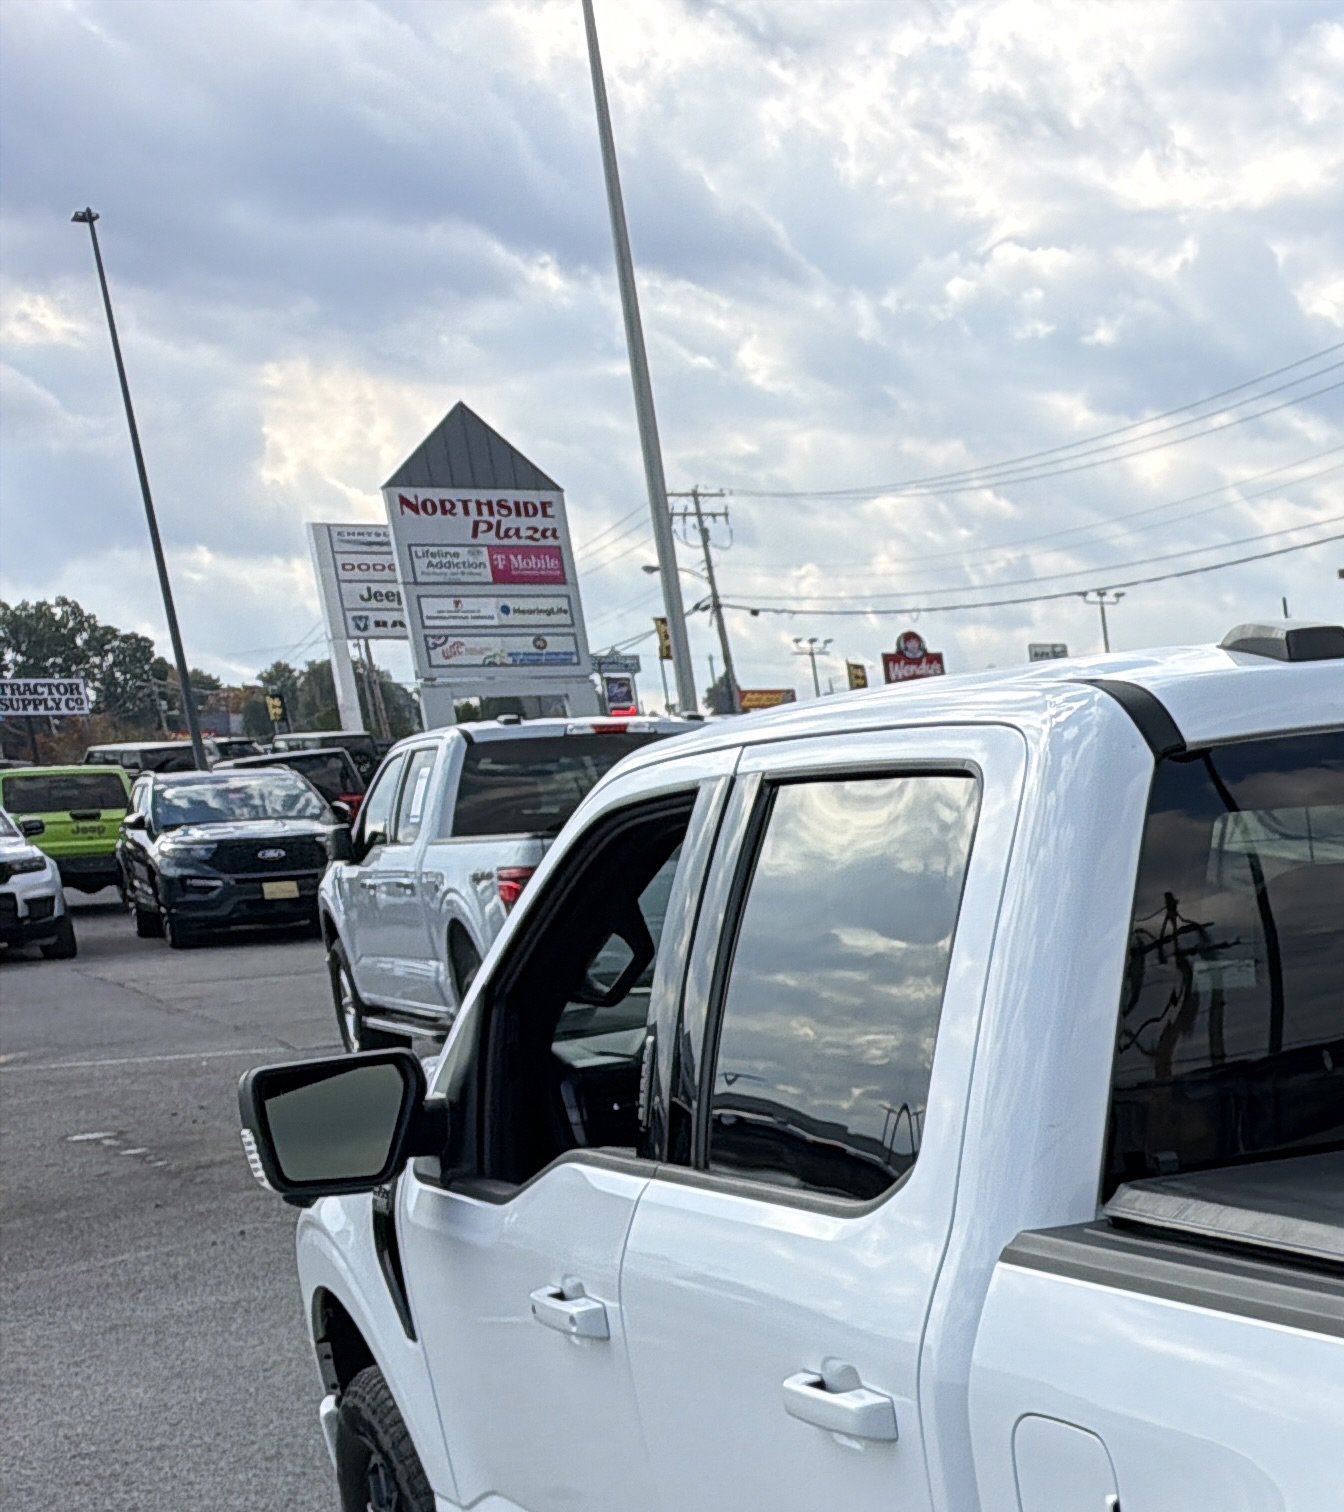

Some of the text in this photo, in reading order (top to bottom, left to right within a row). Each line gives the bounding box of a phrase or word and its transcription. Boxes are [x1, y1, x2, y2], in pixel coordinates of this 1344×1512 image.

[398, 493, 555, 518] NORTHSIDE
[471, 520, 560, 541] Plaza
[414, 549, 460, 559] Lifeline
[341, 563, 396, 572] DODG
[426, 560, 487, 570] Addiction
[510, 554, 560, 570] Mobile
[374, 620, 406, 628] RA
[888, 661, 941, 681] Wendy's
[0, 683, 82, 696] TRACTOR
[0, 698, 62, 711] SUPPLY
